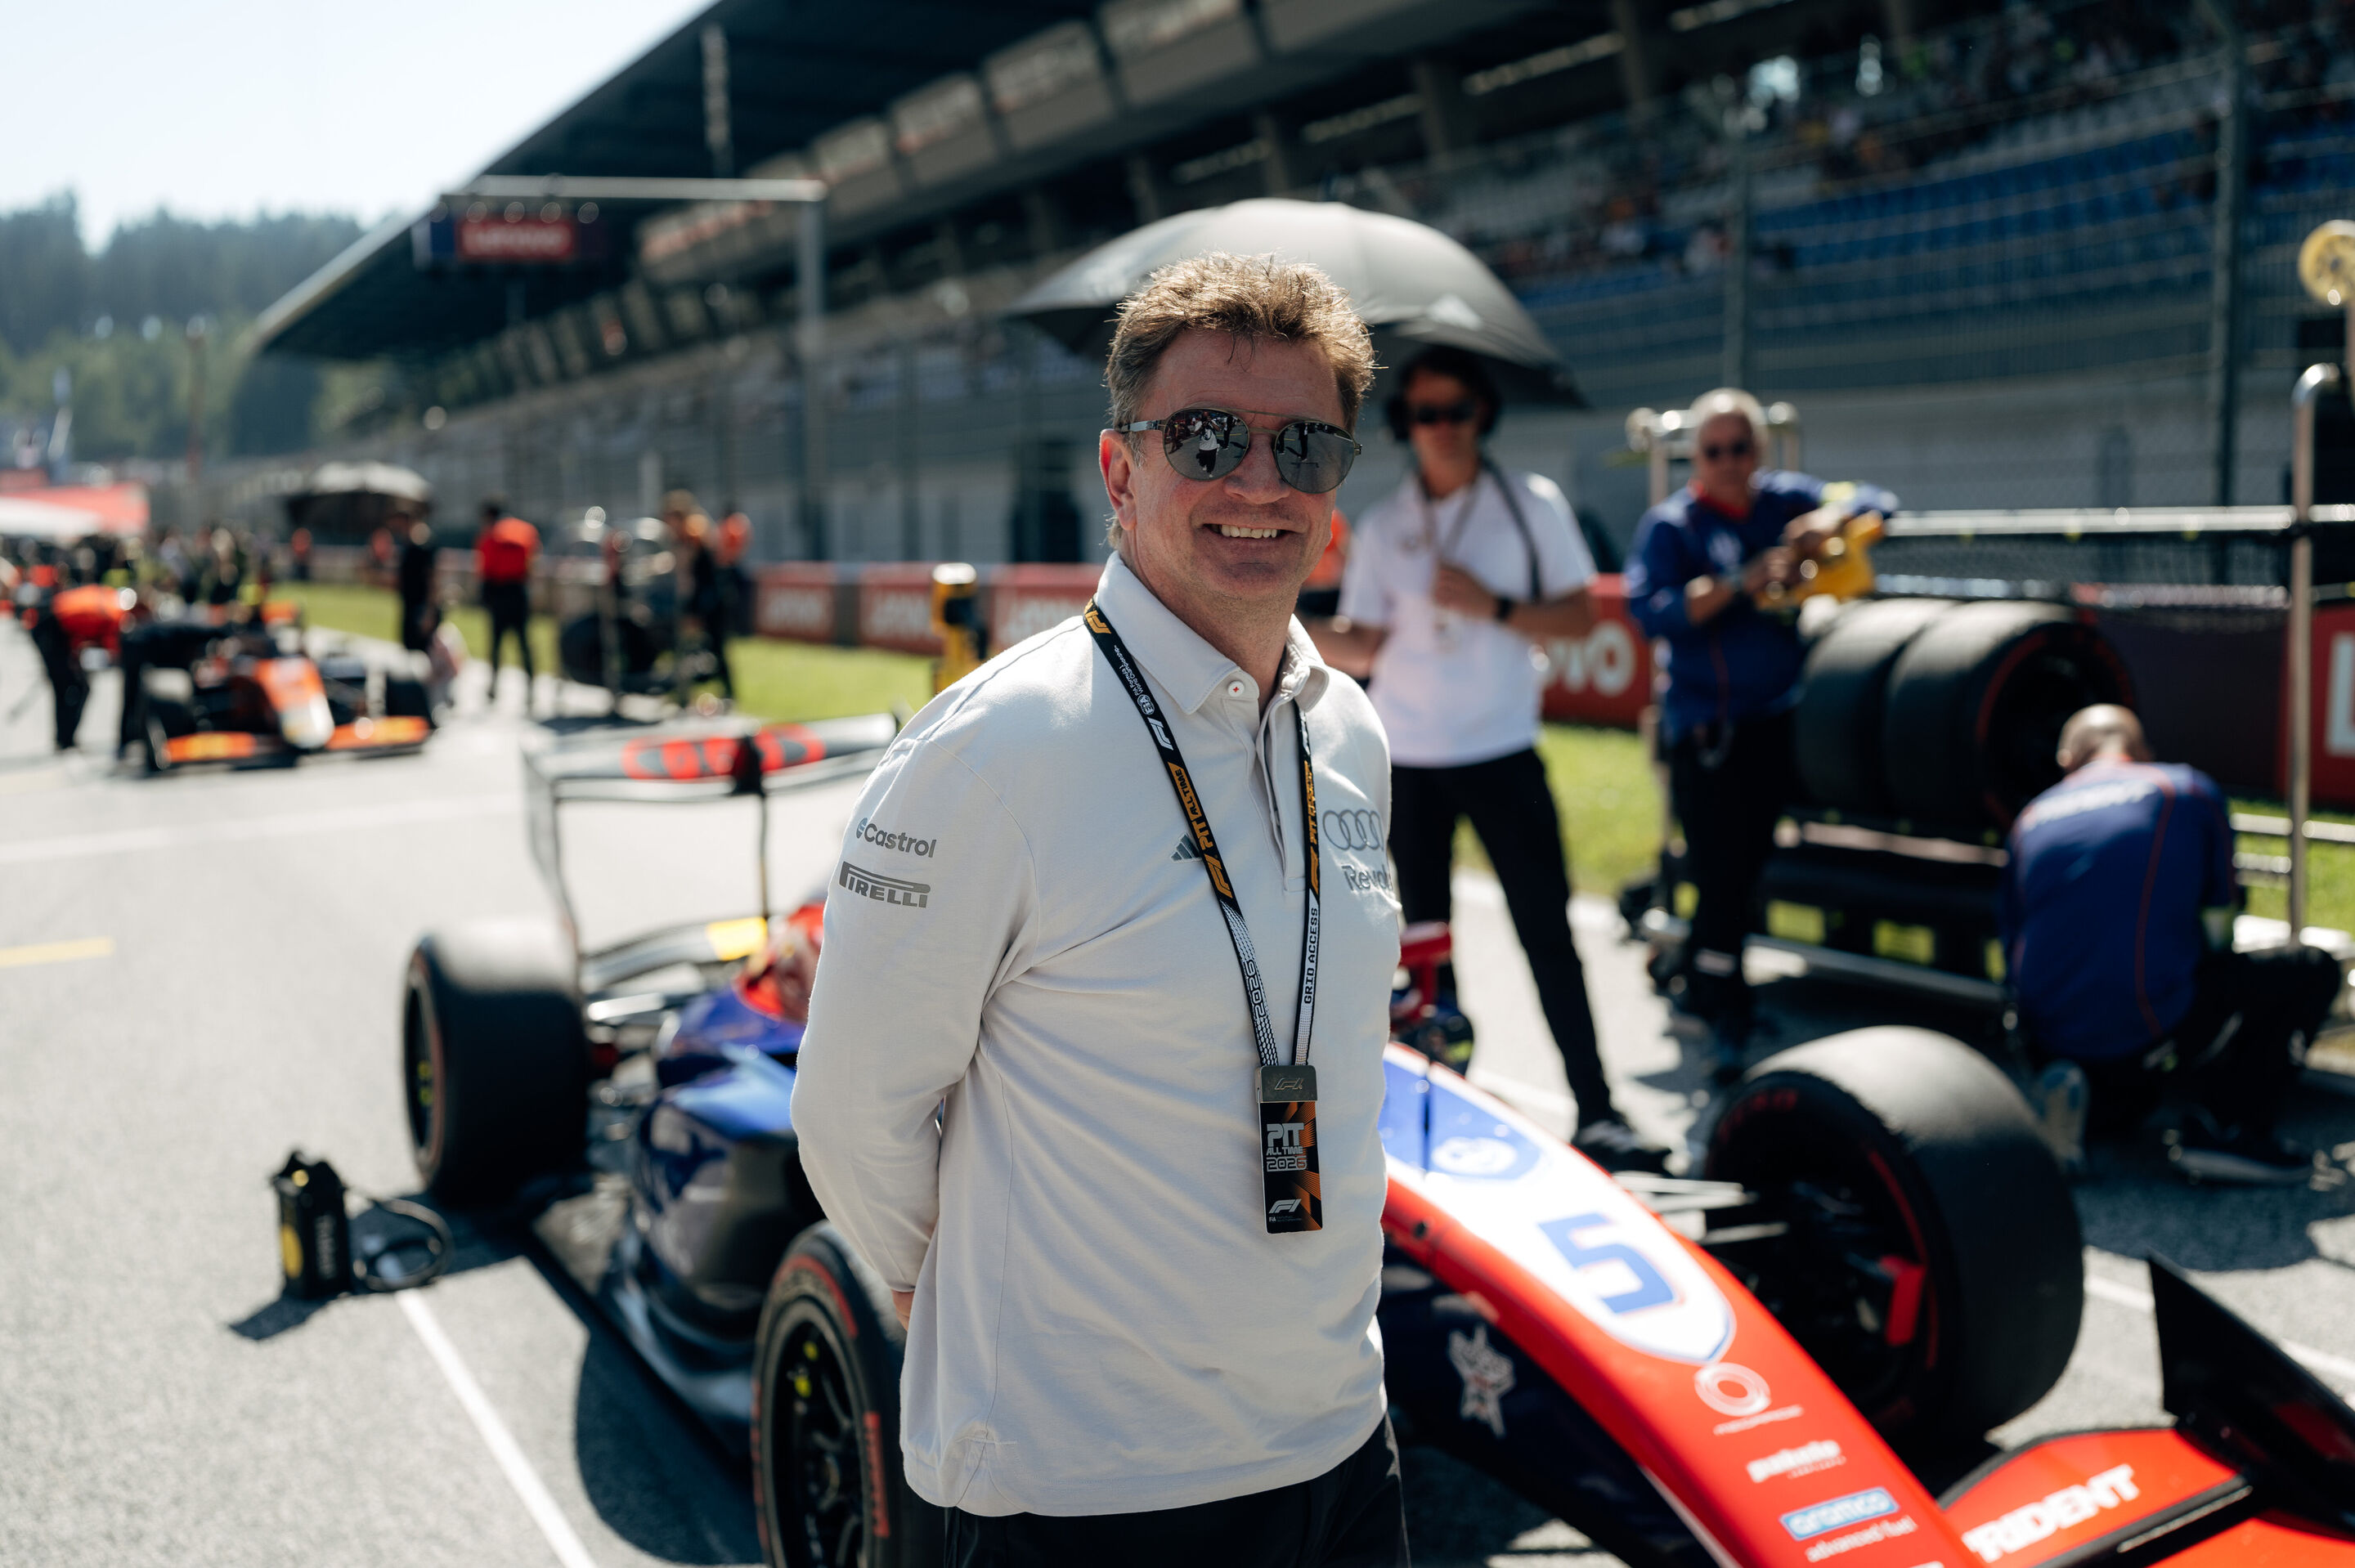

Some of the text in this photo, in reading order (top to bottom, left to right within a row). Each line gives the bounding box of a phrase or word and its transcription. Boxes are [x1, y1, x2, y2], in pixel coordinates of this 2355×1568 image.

[1133, 679, 1143, 696] World
[1147, 717, 1173, 750] F1
[1175, 768, 1214, 850] PIT ALL TIME
[864, 822, 937, 858] Castrol
[839, 861, 931, 908] PIRELLI
[1204, 853, 1233, 898] F1
[1303, 907, 1319, 1005] GRID ACCESS
[1244, 961, 1266, 1018] 2026
[1266, 1146, 1303, 1156] ALL TIME
[1267, 1122, 1304, 1147] PIT
[1266, 1155, 1308, 1172] 2026
[1268, 1198, 1303, 1214] F1
[1536, 1212, 1676, 1315] 5
